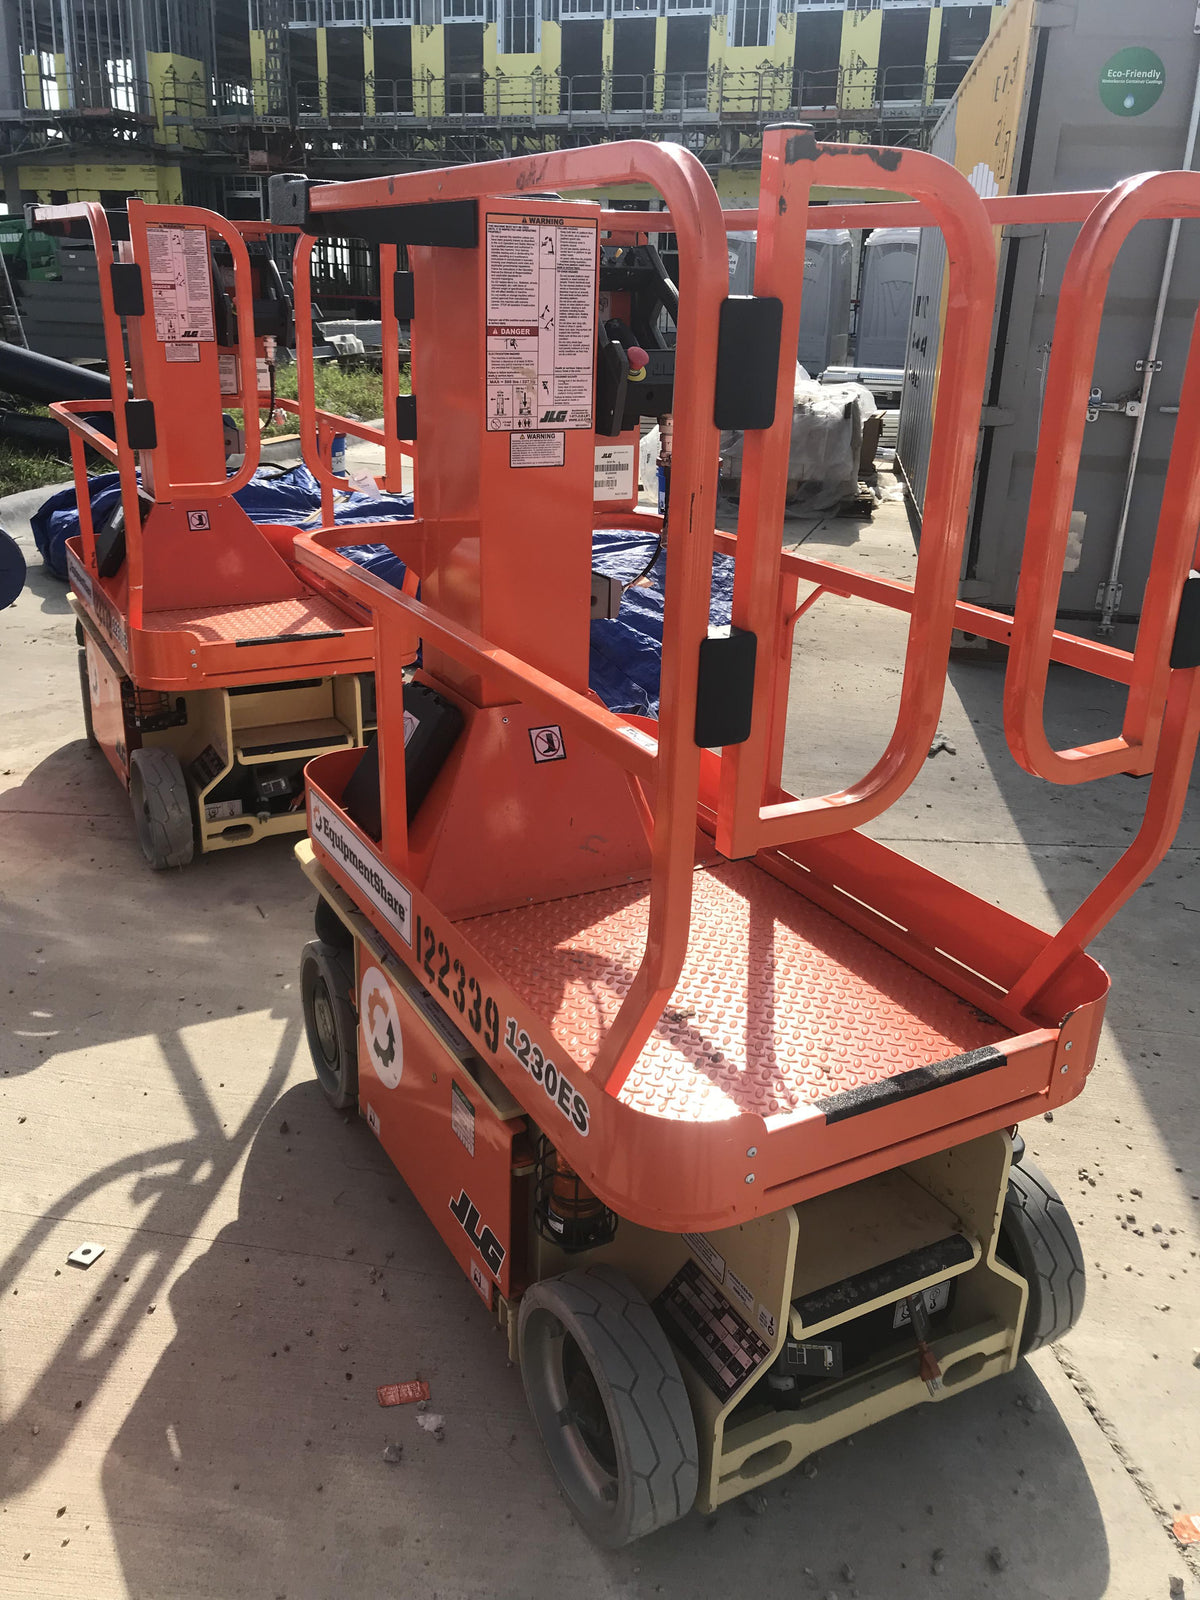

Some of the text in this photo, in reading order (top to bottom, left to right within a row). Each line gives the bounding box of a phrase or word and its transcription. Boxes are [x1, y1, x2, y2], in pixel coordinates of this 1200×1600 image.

[1107, 69, 1161, 79] Eco-Friendly
[647, 113, 677, 121] FRACO
[529, 217, 565, 225] WARNING
[181, 330, 199, 338] JLG
[539, 410, 568, 423] JLG
[323, 816, 406, 923] EquipmentShare
[416, 915, 500, 1055] 122339
[504, 1019, 590, 1134] 1230ES
[449, 1188, 507, 1277] JLG
